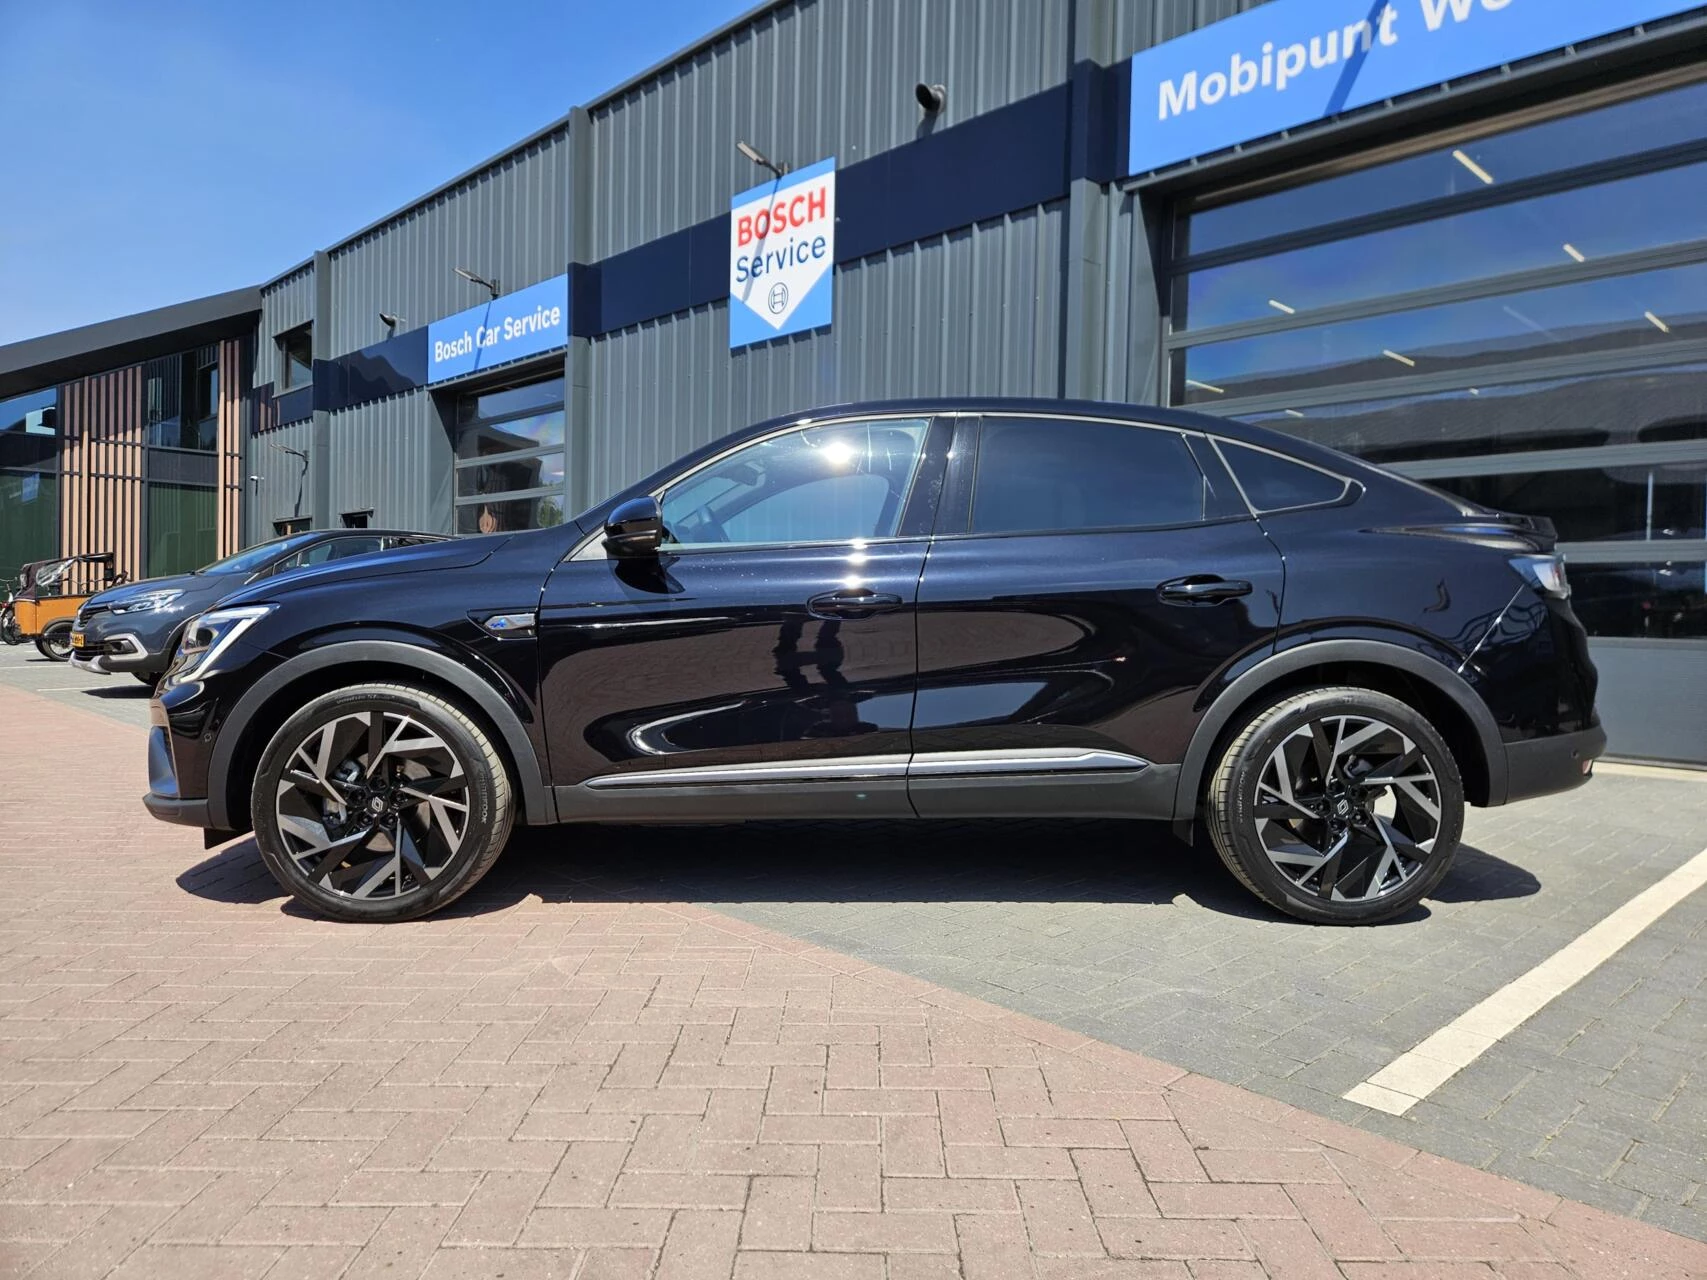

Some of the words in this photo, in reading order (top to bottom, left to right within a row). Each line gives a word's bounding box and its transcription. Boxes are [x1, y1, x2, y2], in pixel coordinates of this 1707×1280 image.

[1158, 5, 1398, 120] Mobipunt
[737, 186, 826, 247] BOSCH
[736, 235, 826, 283] Service
[434, 330, 472, 363] Bosch
[476, 325, 500, 347] Car
[504, 305, 560, 341] Service
